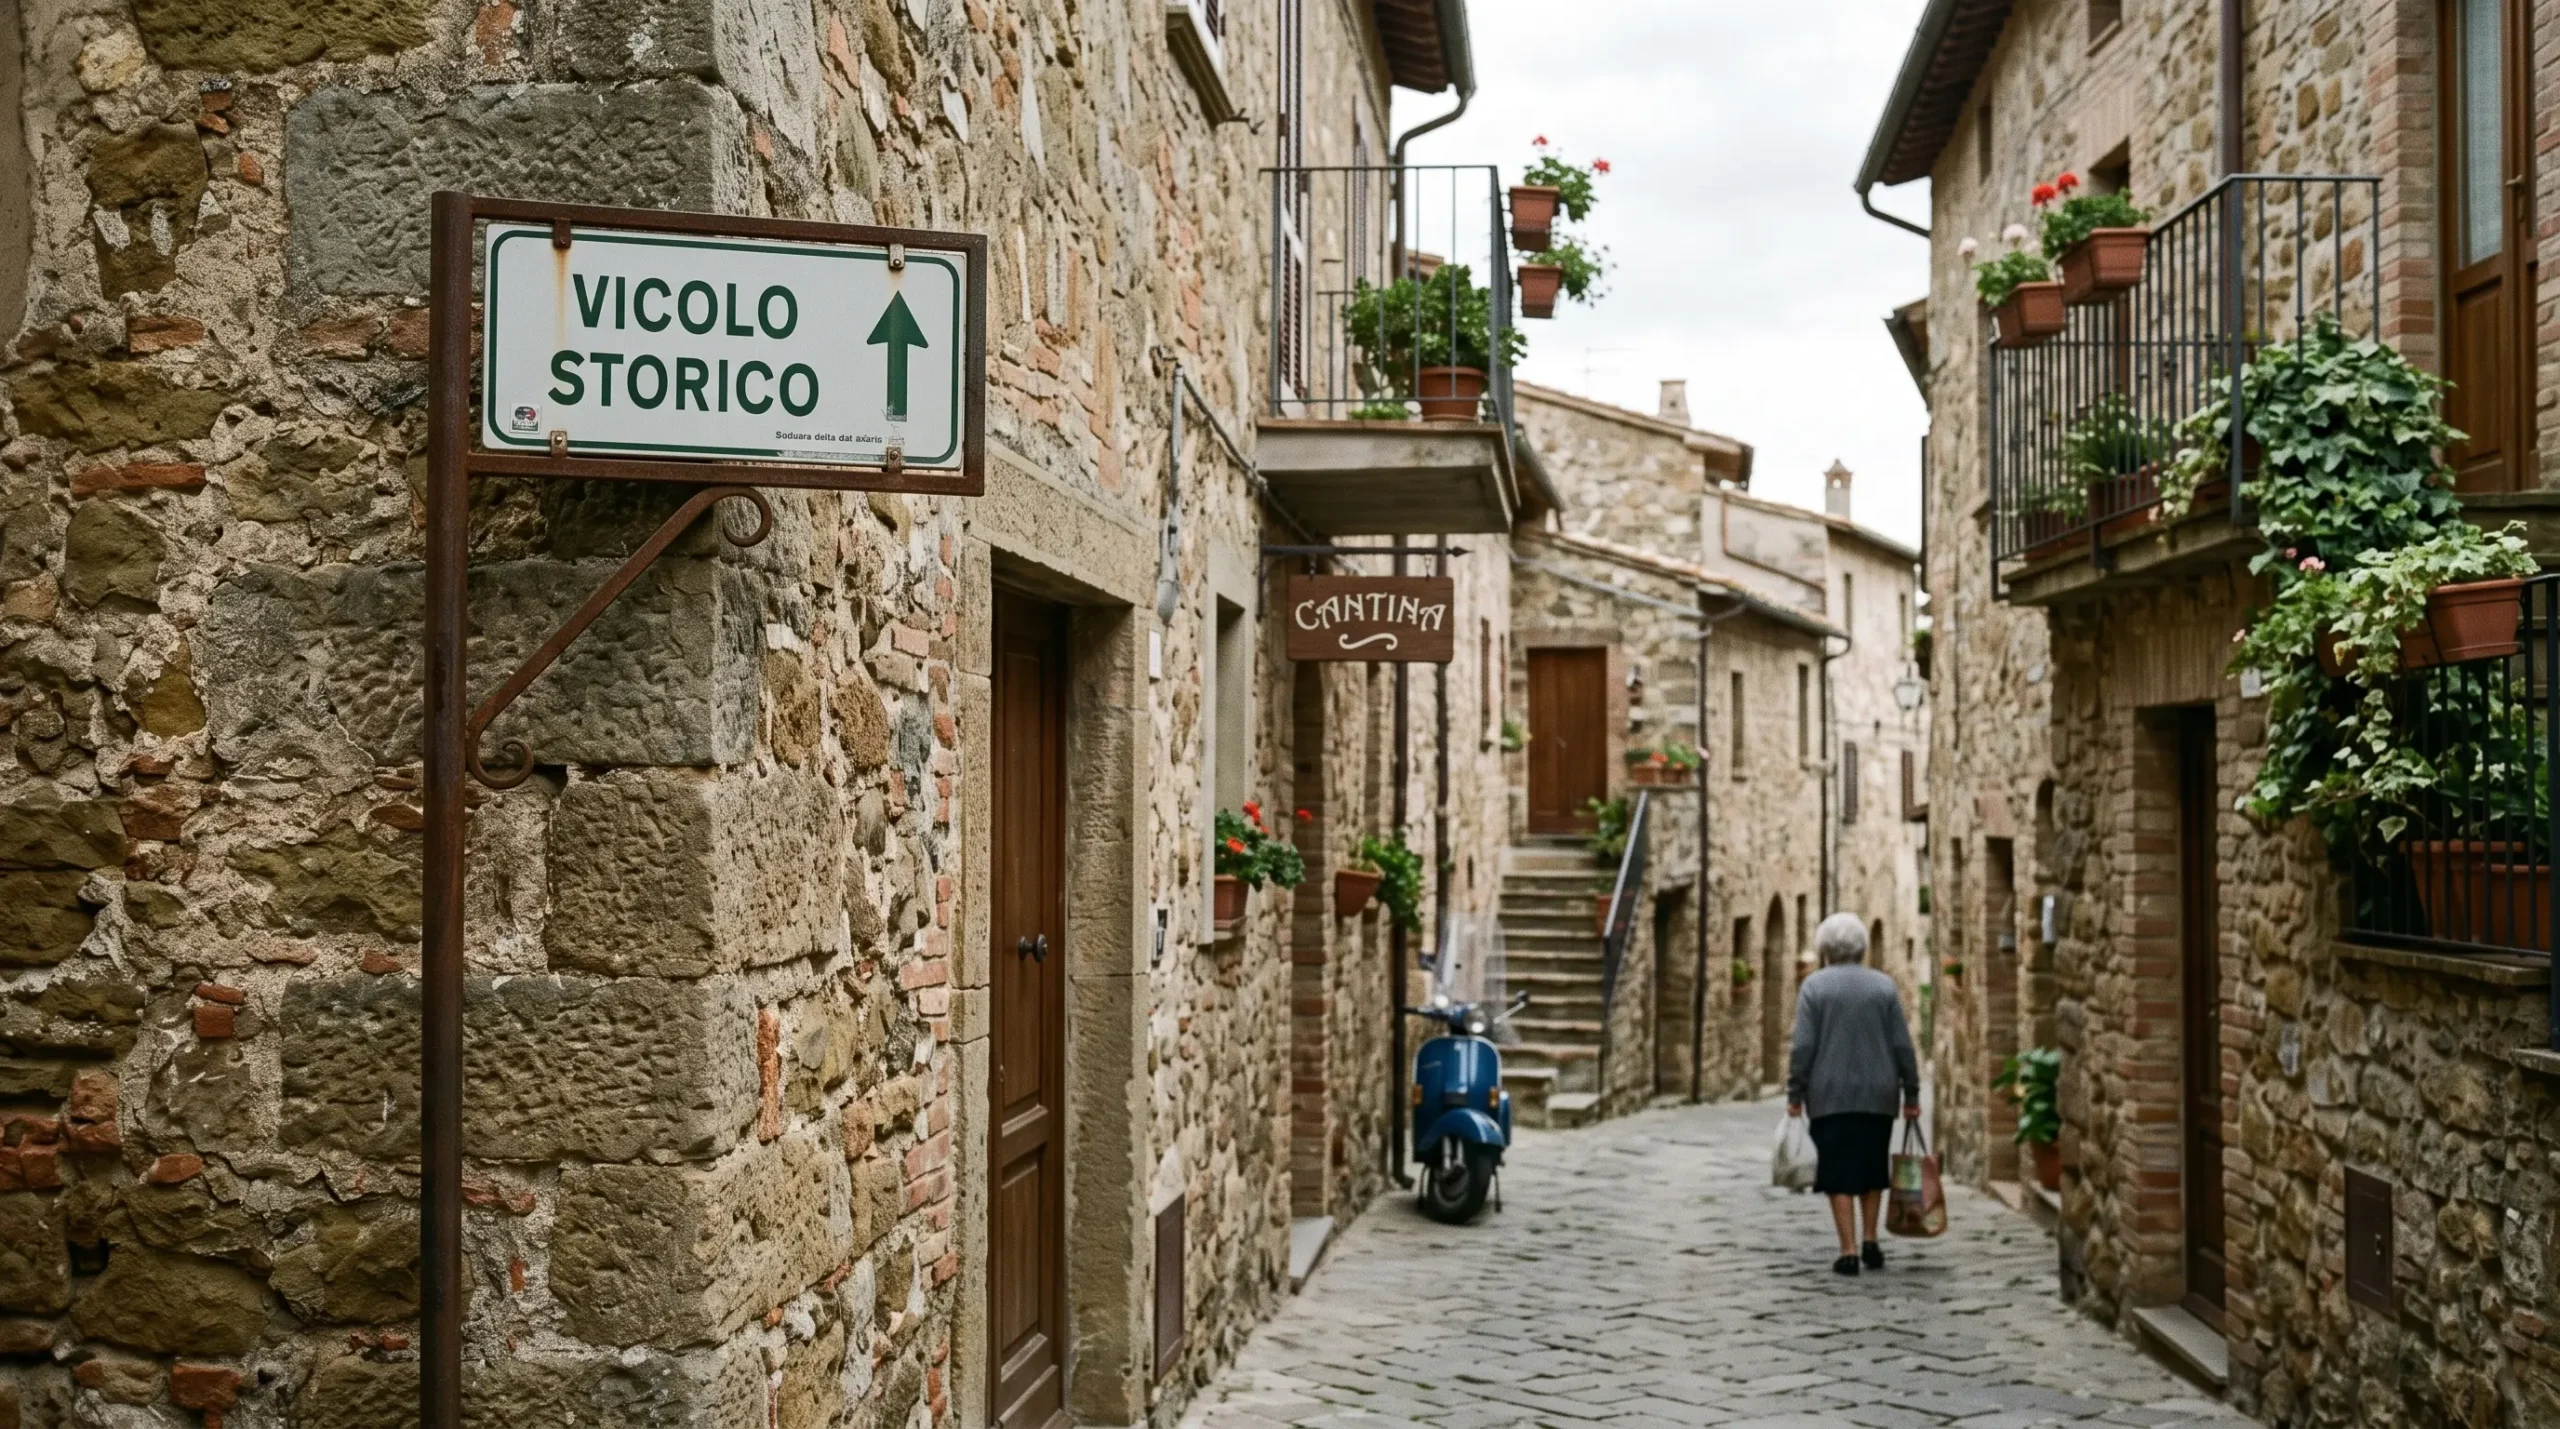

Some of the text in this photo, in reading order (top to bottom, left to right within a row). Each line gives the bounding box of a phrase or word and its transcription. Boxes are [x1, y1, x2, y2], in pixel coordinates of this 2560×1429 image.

[572, 273, 798, 340] VICOLO
[547, 349, 820, 417] STORICO
[1295, 592, 1446, 632] CANTINA
